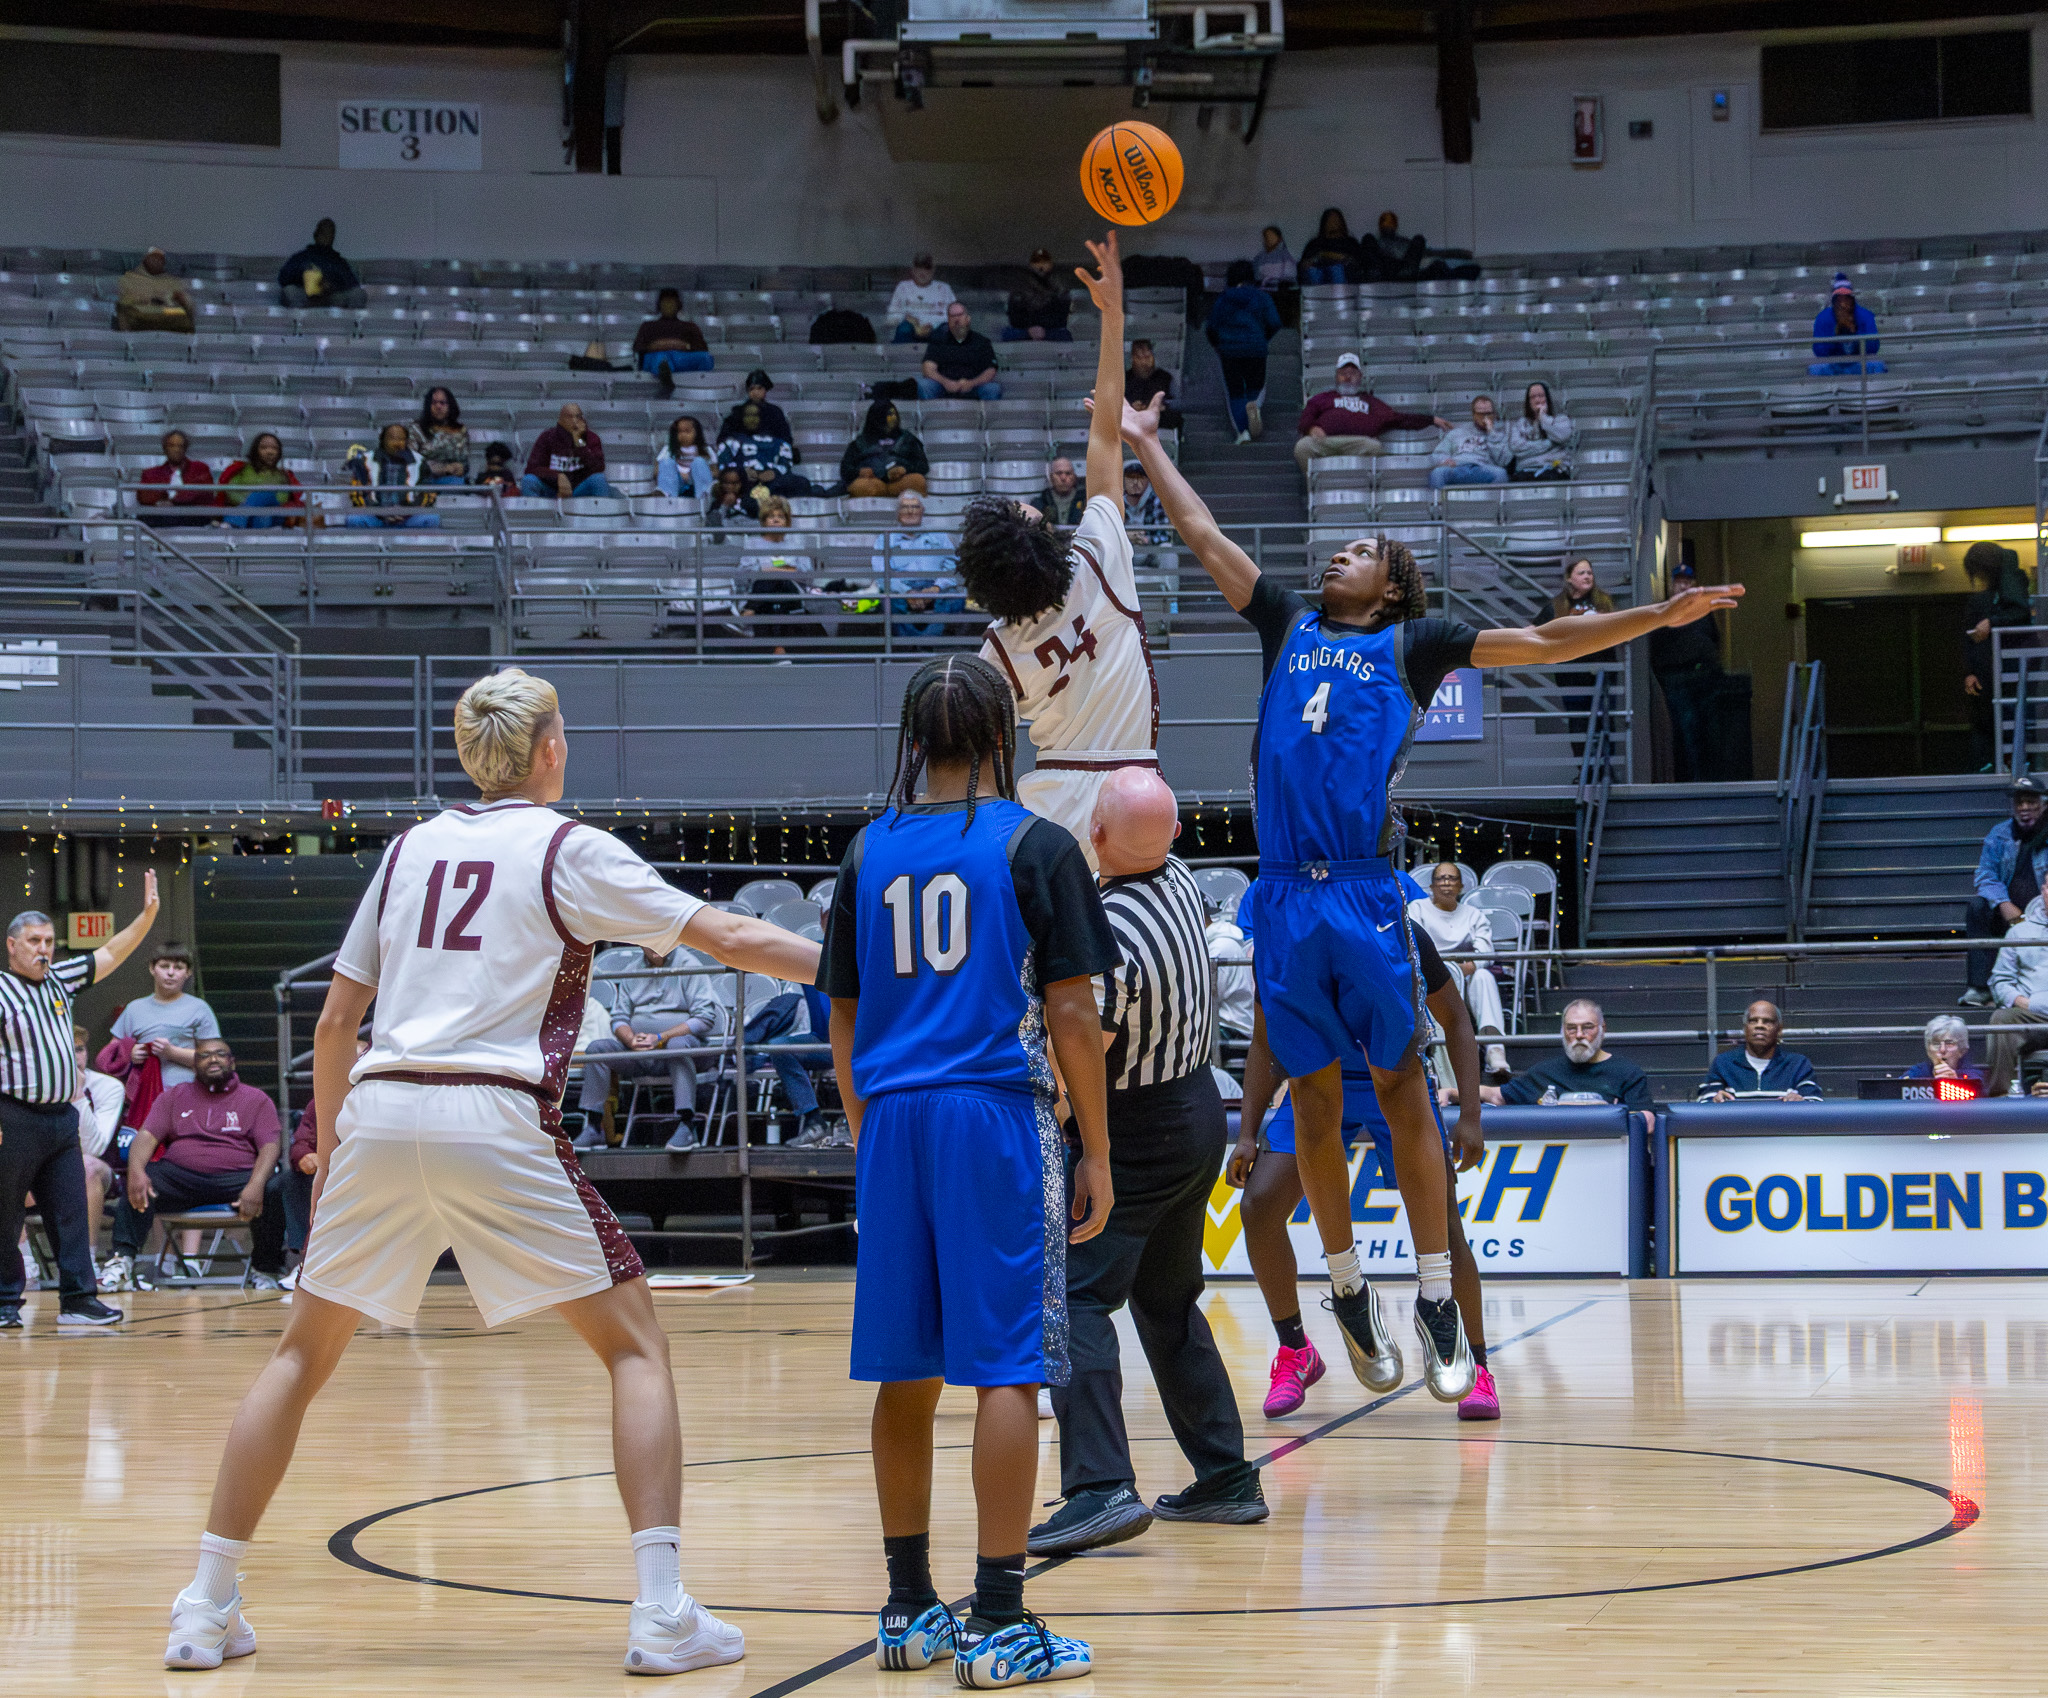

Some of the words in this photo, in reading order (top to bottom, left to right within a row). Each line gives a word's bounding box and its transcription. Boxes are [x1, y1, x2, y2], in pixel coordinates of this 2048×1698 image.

[341, 106, 479, 136] SECTION
[401, 135, 420, 160] 3
[1099, 167, 1128, 213] NCAA
[1124, 144, 1158, 212] Wilson
[1852, 467, 1880, 490] EXIT
[1288, 646, 1375, 682] COUGARS
[1302, 682, 1334, 734] 4
[416, 860, 495, 952] 12
[77, 915, 107, 938] EXIT
[882, 872, 972, 979] 10
[1902, 1086, 1935, 1101] POSS
[1704, 1171, 1983, 1233] GOLDEN
[2003, 1170, 2048, 1229] B
[1104, 1488, 1132, 1511] HOKA
